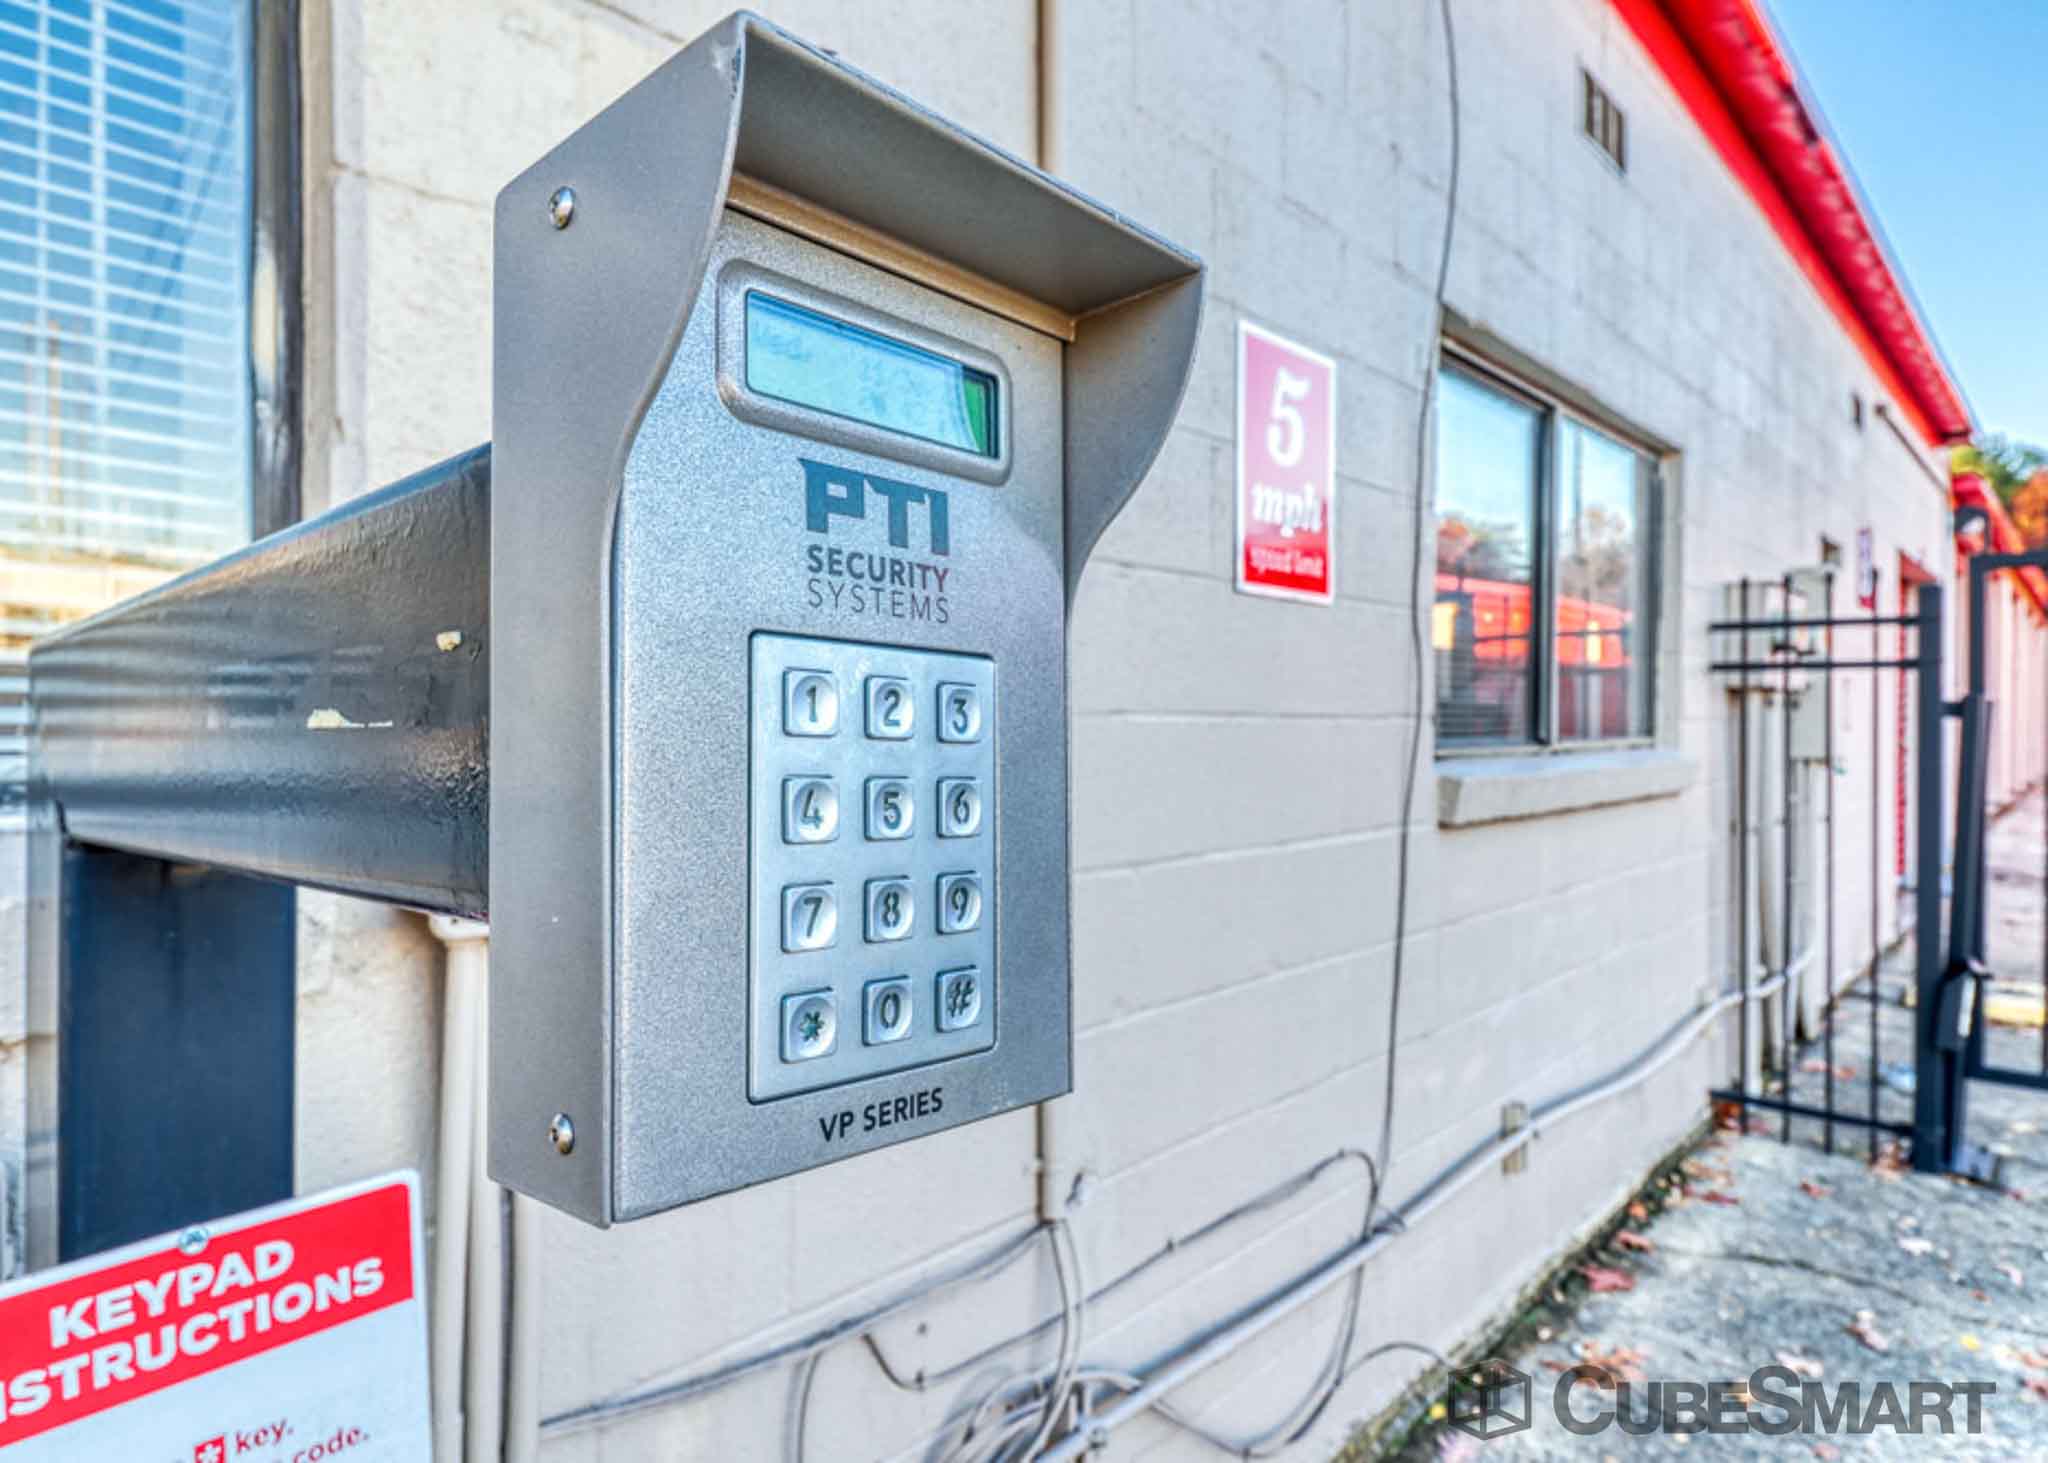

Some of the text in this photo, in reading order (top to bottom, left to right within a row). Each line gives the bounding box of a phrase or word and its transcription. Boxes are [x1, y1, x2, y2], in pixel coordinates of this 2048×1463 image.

[1267, 366, 1312, 467] 5
[797, 457, 949, 556] PTI
[1252, 482, 1321, 538] mph
[806, 544, 949, 592] SECURITY
[807, 578, 949, 624] SYSTEMS
[806, 684, 969, 735] 1 2 3
[801, 788, 970, 829] 4 5 6
[803, 886, 969, 939] 7 8 9
[880, 993, 900, 1029] 0
[946, 980, 974, 1017] #
[819, 1087, 943, 1142] VP SERIES
[49, 1240, 294, 1349] KEYPAD
[0, 1257, 384, 1424] STRUCTIONS
[234, 1418, 294, 1455] key.
[292, 1426, 370, 1463] code.
